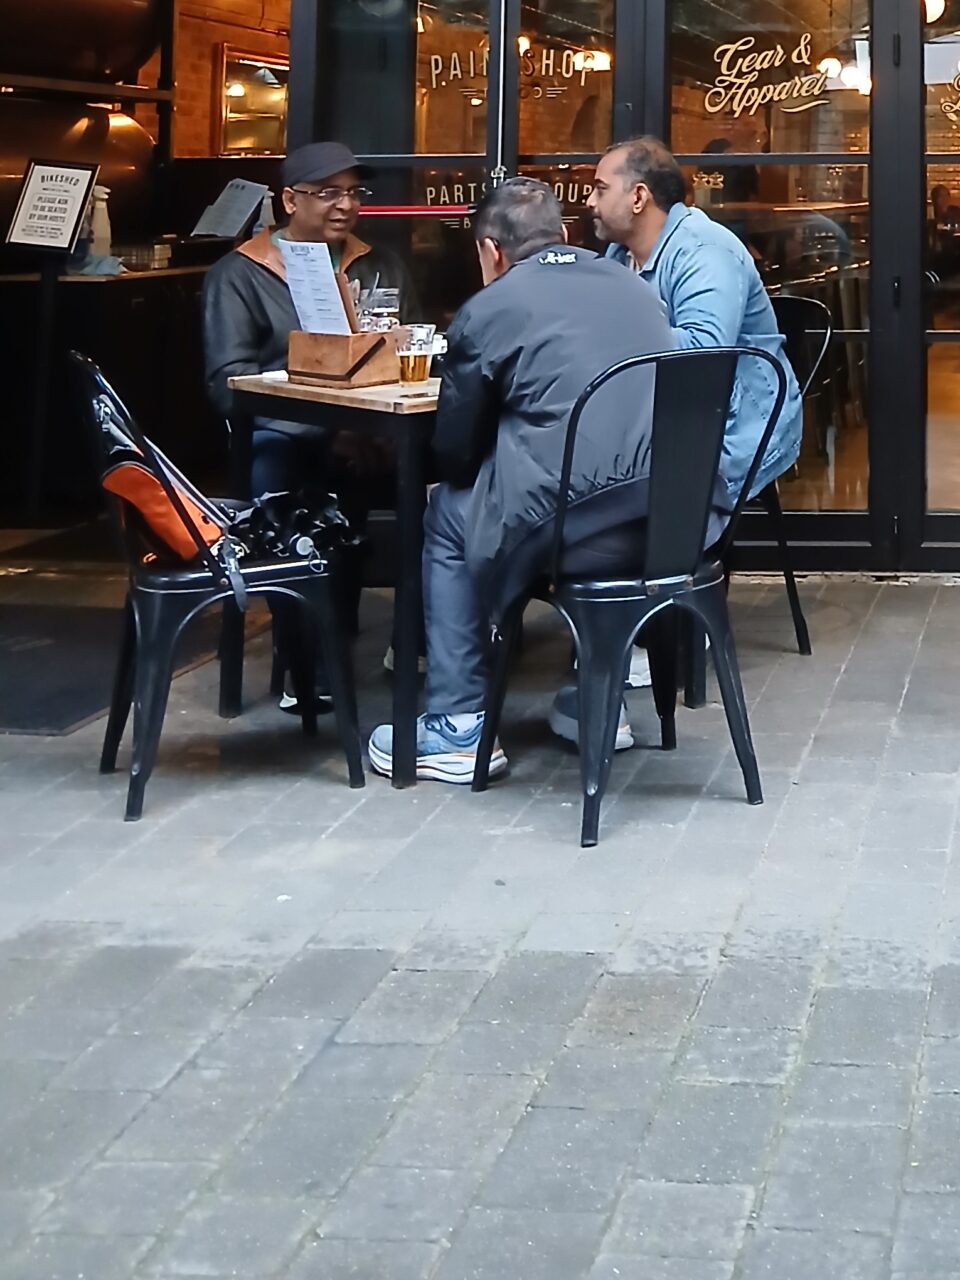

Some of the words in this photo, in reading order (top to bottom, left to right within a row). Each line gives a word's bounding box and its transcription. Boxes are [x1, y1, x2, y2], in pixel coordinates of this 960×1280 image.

[713, 36, 787, 81] Gear
[791, 32, 811, 65] &
[704, 66, 830, 119] Apparel
